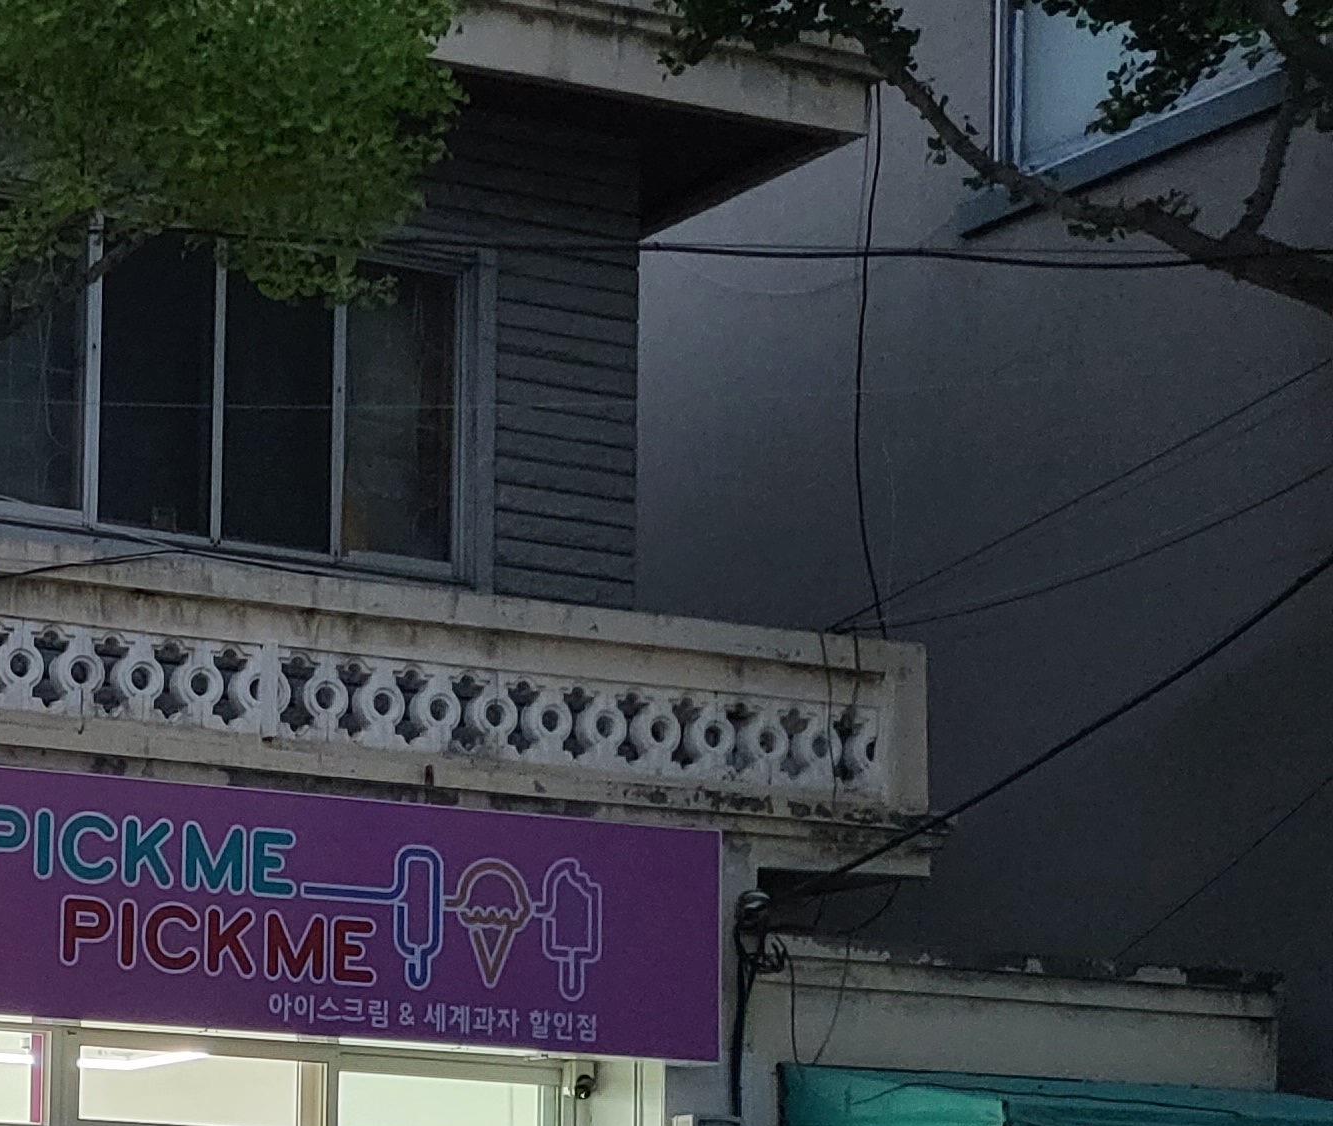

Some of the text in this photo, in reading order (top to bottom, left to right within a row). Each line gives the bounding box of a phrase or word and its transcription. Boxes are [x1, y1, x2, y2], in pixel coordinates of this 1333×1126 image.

[60, 895, 377, 988] PICKME
[268, 993, 598, 1042] 아이스크림 & 세계과자 할인점
